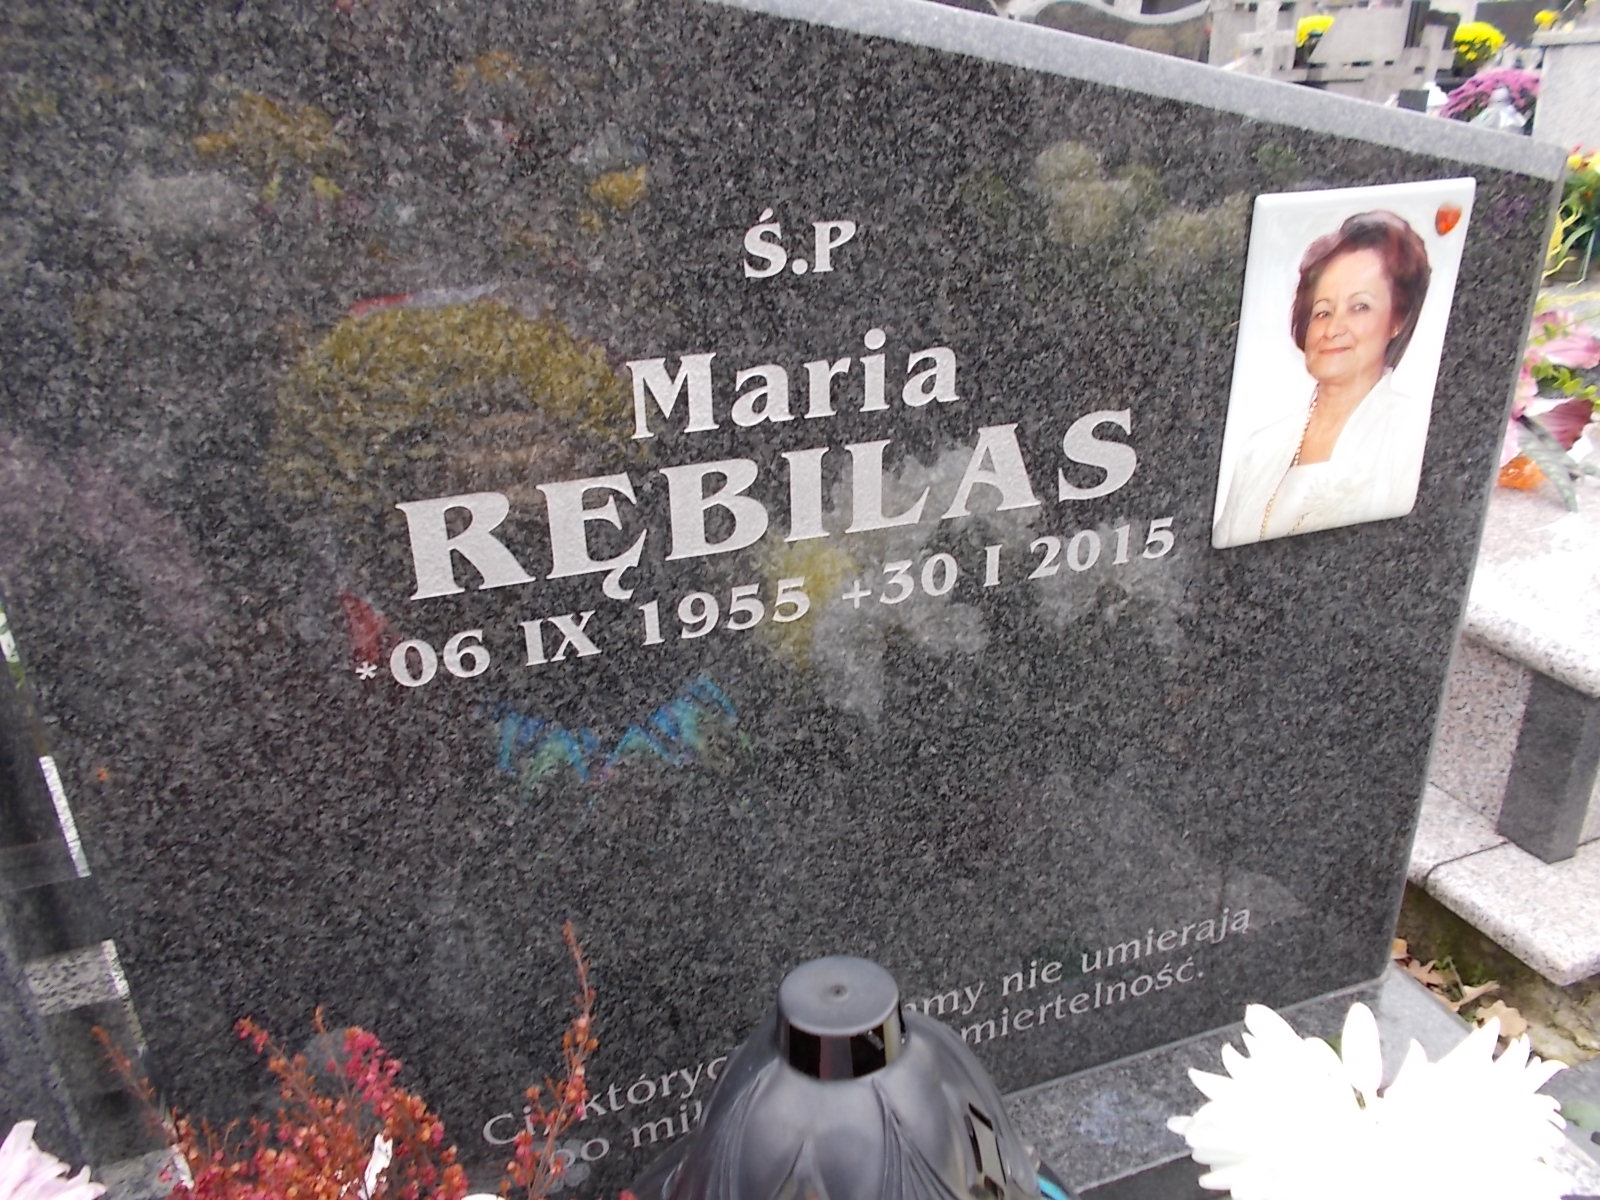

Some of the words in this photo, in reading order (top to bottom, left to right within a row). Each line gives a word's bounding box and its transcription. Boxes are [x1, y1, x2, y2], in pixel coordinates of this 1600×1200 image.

[743, 208, 856, 278] Ś.P
[626, 327, 960, 439] Maria
[395, 408, 1138, 601] RĘBILAS
[520, 610, 602, 667] IX
[638, 576, 811, 646] 1955
[984, 545, 1002, 587] I
[1028, 517, 1175, 580] 2015
[579, 1056, 728, 1121] któryc
[1001, 961, 1063, 996] nie
[1081, 907, 1251, 974] umierają
[960, 956, 1206, 1046] miertelność.
